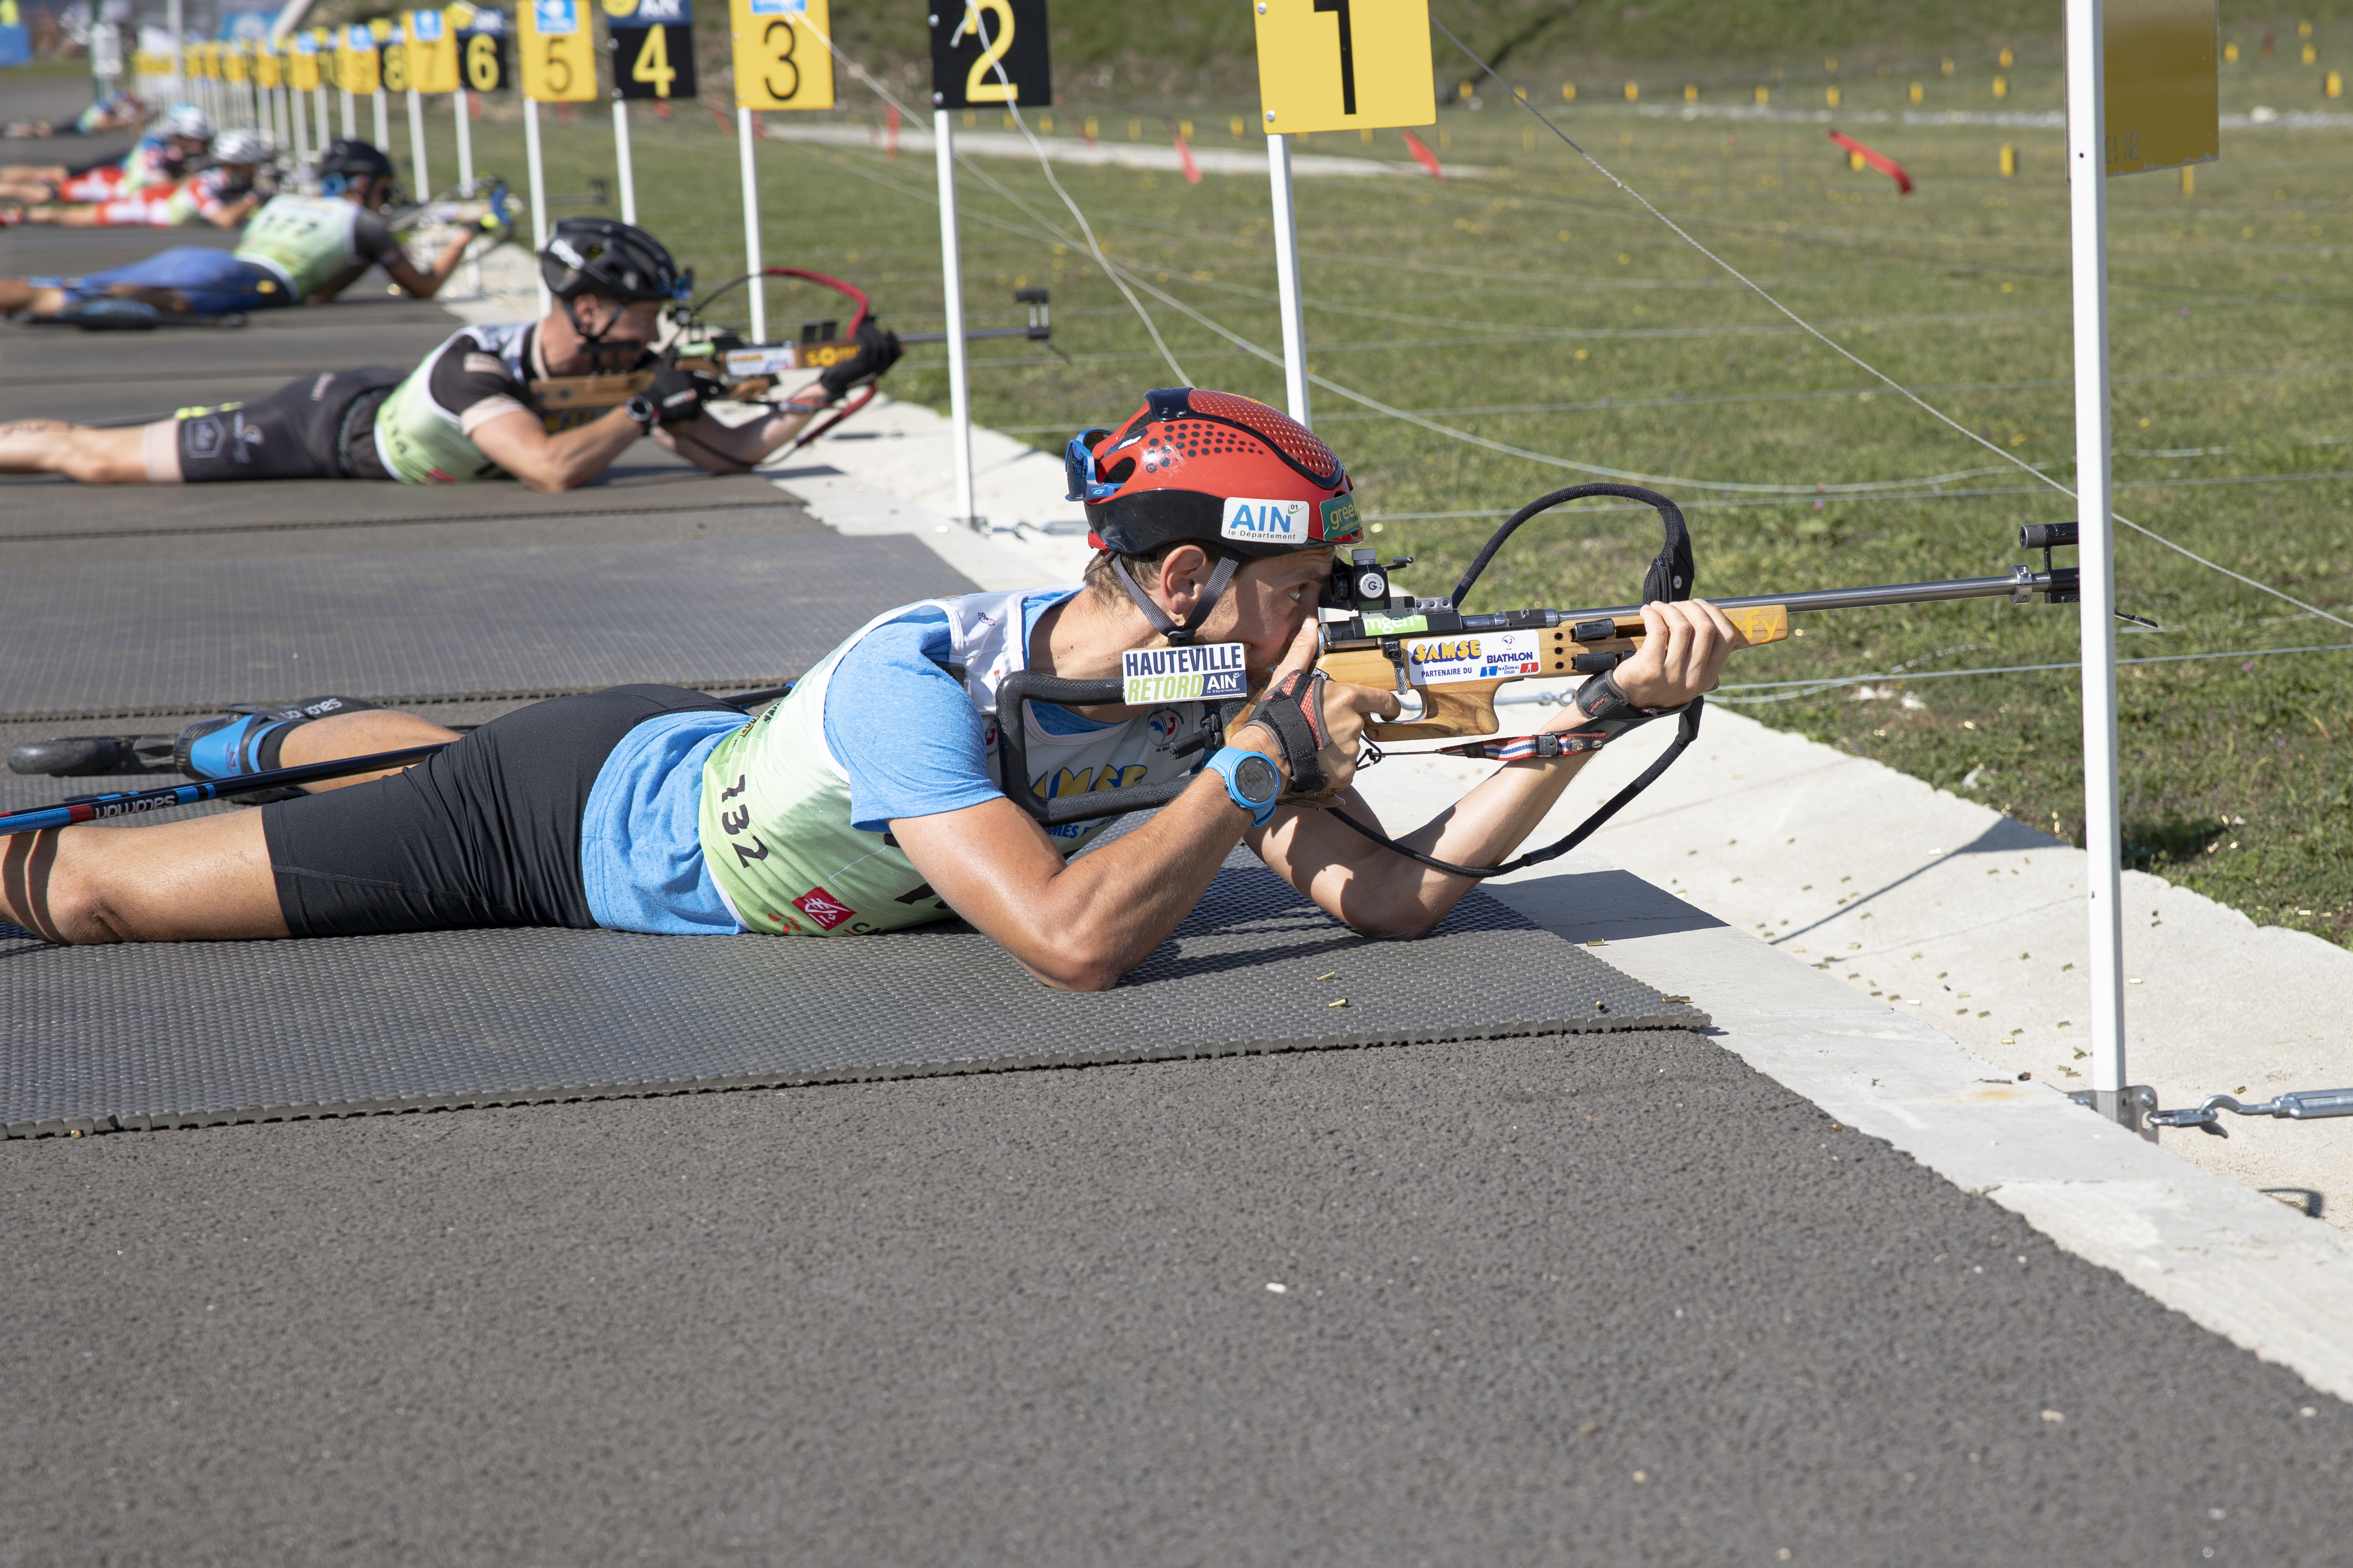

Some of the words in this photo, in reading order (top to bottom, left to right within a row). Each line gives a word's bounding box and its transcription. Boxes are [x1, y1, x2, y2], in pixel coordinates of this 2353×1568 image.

[467, 32, 500, 92] 6
[546, 37, 572, 94] 5
[632, 23, 677, 98] 4
[764, 19, 800, 102] 3
[966, 0, 1018, 102] 2
[1314, 0, 1356, 115] 1
[1230, 505, 1291, 533] AIN
[1240, 530, 1296, 540] Département
[1364, 616, 1414, 634] mgen
[1125, 645, 1242, 677] HAUTEVILLE
[1411, 640, 1482, 665] SAMSE
[1487, 651, 1533, 664] BIATHLON
[1127, 674, 1203, 702] RETORD
[1207, 674, 1237, 690] AIN
[1421, 668, 1461, 678] PARTENAIRE
[722, 774, 768, 869] 132
